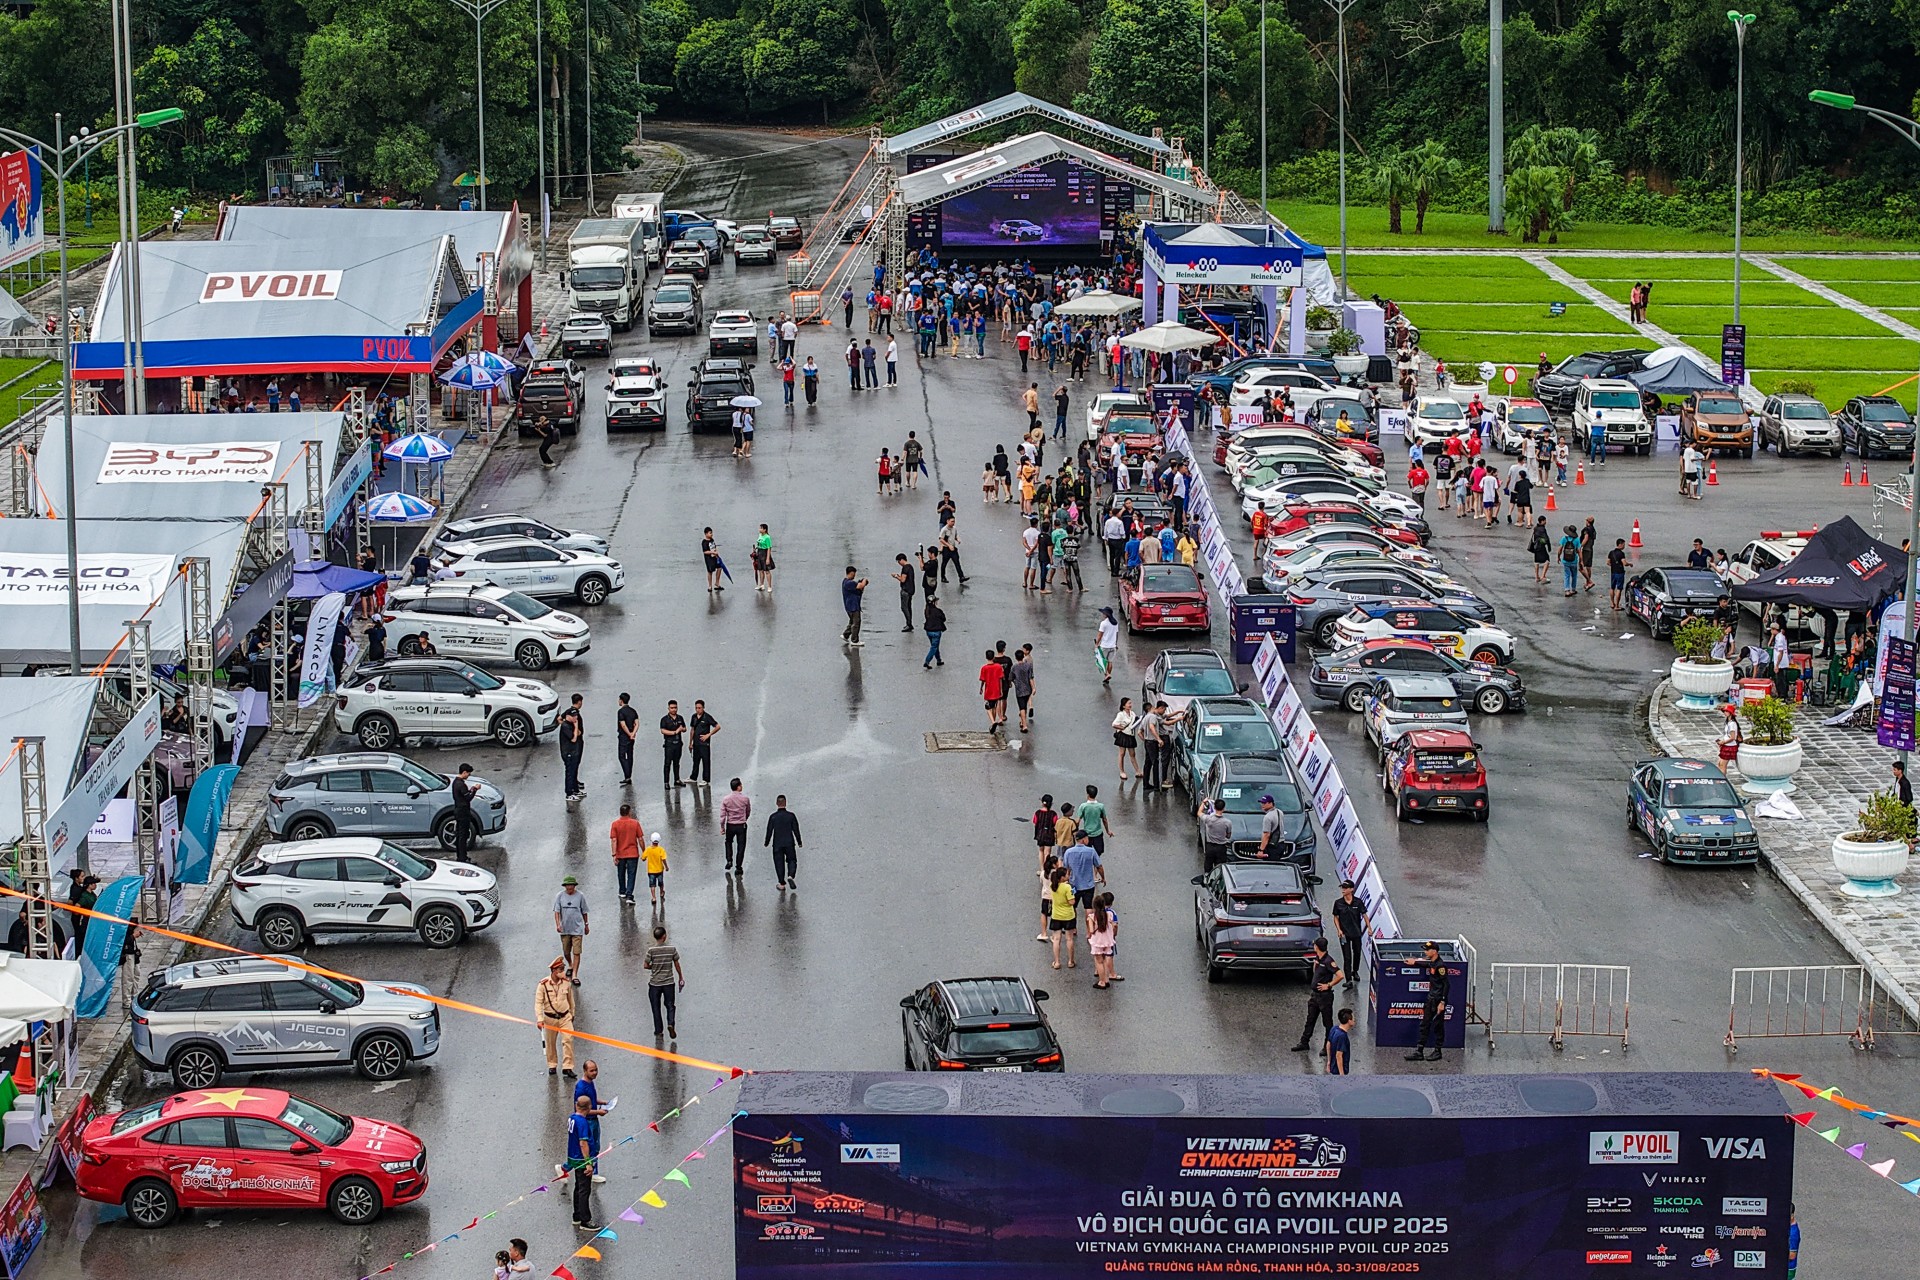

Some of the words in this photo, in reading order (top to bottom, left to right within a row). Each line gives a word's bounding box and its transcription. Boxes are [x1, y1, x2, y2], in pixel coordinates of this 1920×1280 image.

[1250, 272, 1282, 280] Heineken
[203, 274, 335, 299] PVOIL
[362, 338, 414, 361] PVOIL
[108, 447, 274, 466] BYD
[128, 468, 172, 476] AUTO
[177, 468, 230, 476] THANH
[234, 466, 269, 476] HÓA
[0, 566, 130, 578] TASCO
[102, 582, 140, 592] HÓA
[1304, 750, 1322, 784] VISA
[354, 806, 367, 814] 06
[1333, 814, 1348, 850] VISA
[285, 1022, 346, 1036] JAECOO
[1186, 1137, 1270, 1150] VIETNAM
[1624, 1134, 1672, 1154] PVOIL
[1700, 1138, 1766, 1159] VISA
[1181, 1153, 1296, 1168] GYMKHANA
[1179, 1168, 1259, 1178] CHAMPIONSHIP
[1260, 1169, 1292, 1178] PVOIL
[1292, 1169, 1314, 1178] CUP
[1316, 1169, 1339, 1178] 2025
[182, 1175, 210, 1189] ĐỘC
[210, 1174, 232, 1190] LẬP
[241, 1174, 283, 1190] THỐNG
[283, 1176, 315, 1190] NHẤT
[760, 1198, 792, 1206] OTV
[1121, 1186, 1164, 1208] GIẢI
[1170, 1192, 1216, 1208] ĐUA
[1222, 1188, 1237, 1208] Ô
[1243, 1188, 1271, 1208] TÔ
[1277, 1192, 1404, 1208] GYMKHANA
[1587, 1198, 1632, 1207] BYD
[1077, 1213, 1107, 1234] VÔ
[1112, 1217, 1163, 1238] ĐỊCH
[1169, 1210, 1228, 1236] QUỐC
[1234, 1218, 1270, 1234] GIA
[1278, 1218, 1340, 1234] PVOIL
[1346, 1218, 1388, 1234] CUP
[1393, 1218, 1448, 1234] 2025
[1076, 1241, 1139, 1254] VIETNAM
[1143, 1242, 1223, 1254] GYMKHANA
[1227, 1242, 1334, 1254] CHAMPIONSHIP
[1338, 1242, 1379, 1254] PVOIL
[1382, 1242, 1410, 1254] CUP
[1414, 1242, 1449, 1254] 2025
[1738, 1252, 1762, 1262] DBV
[1104, 1259, 1145, 1272] QUẢNG
[1147, 1260, 1194, 1272] TRƯỜNG
[1196, 1260, 1222, 1272] HÀM
[1226, 1259, 1261, 1274] RỒNG,
[1264, 1264, 1302, 1273] THANH
[1306, 1261, 1333, 1274] HÓA,
[1336, 1262, 1420, 1274] 30-31/08/2025
